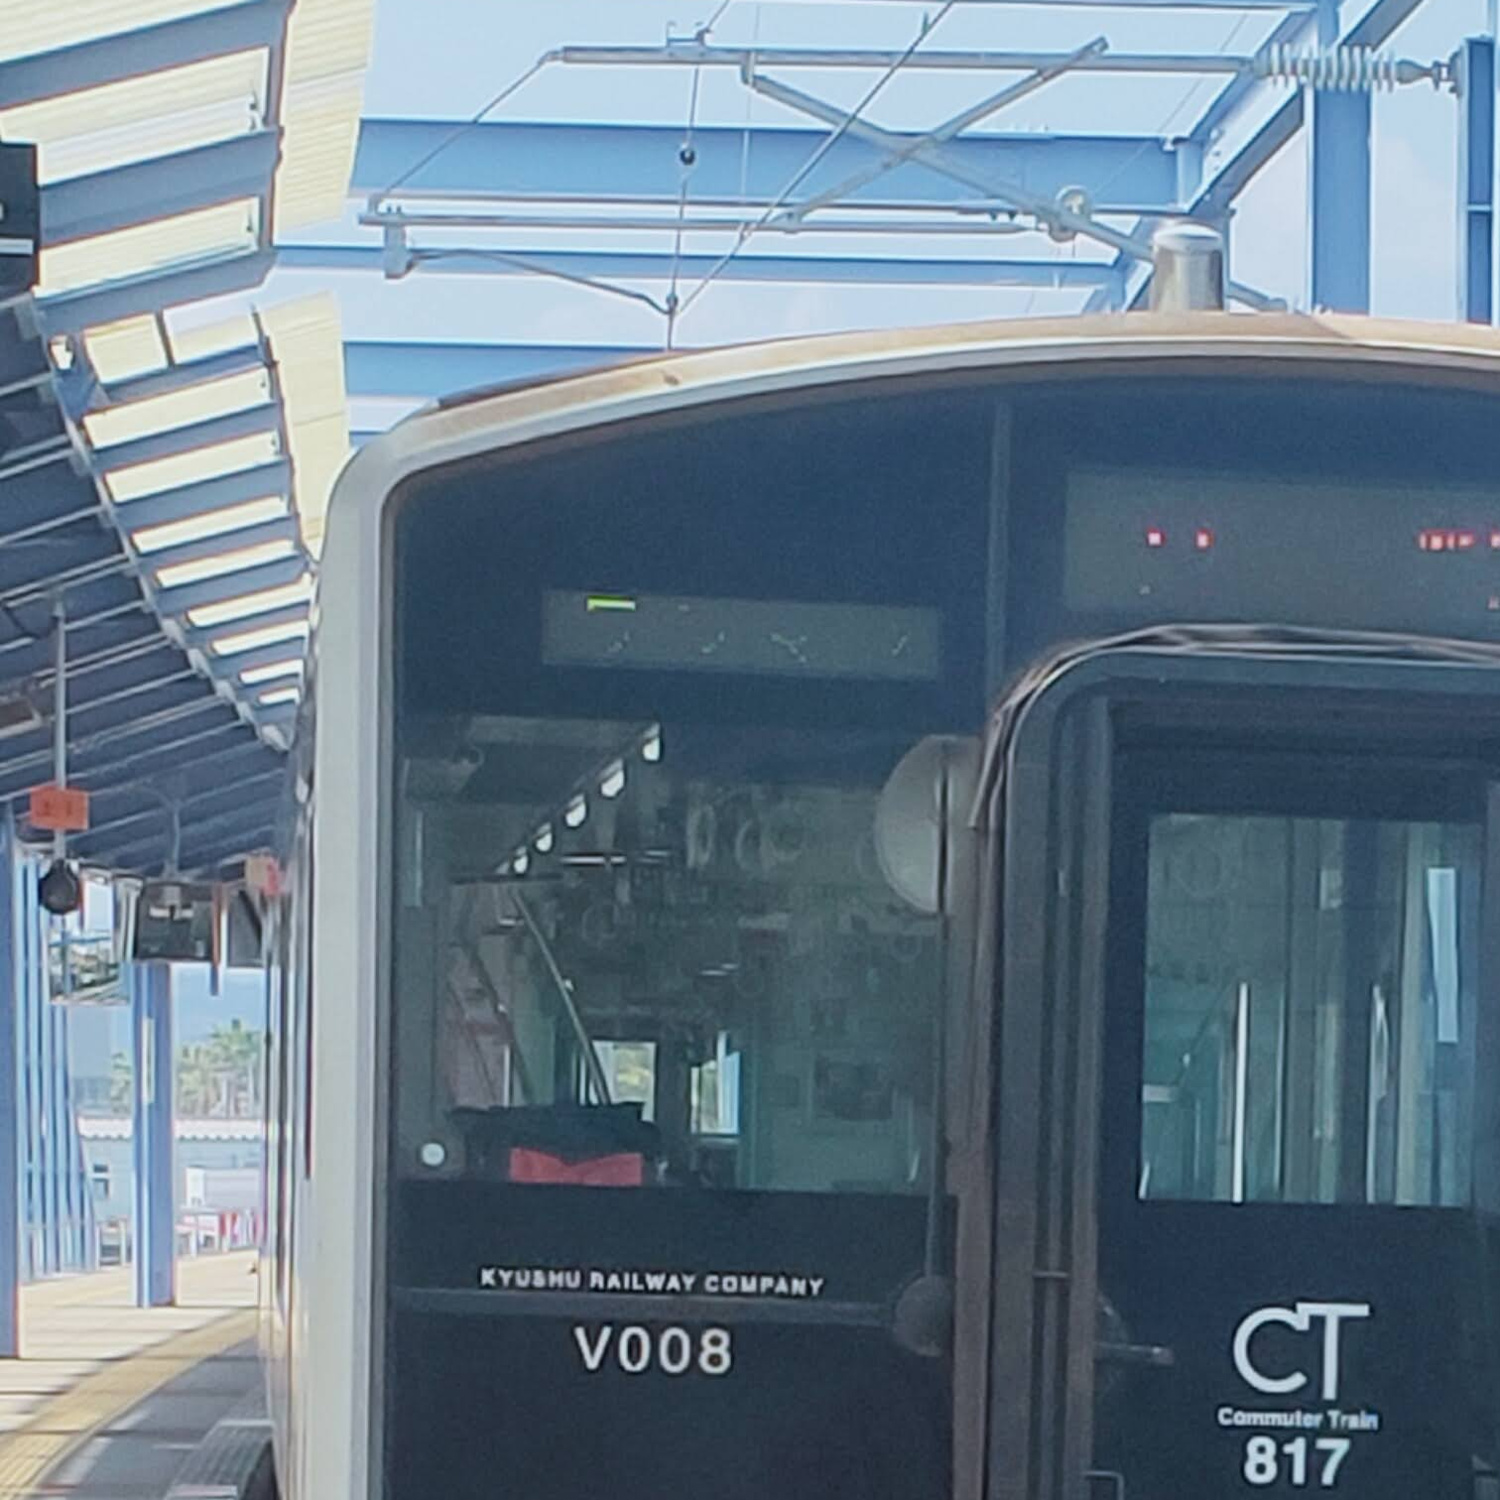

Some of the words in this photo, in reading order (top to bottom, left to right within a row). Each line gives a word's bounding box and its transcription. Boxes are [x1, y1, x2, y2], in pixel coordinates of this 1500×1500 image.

[480, 1267, 581, 1289] KYUSHU
[590, 1272, 697, 1292] RAILWAY
[704, 1275, 824, 1296] COMPANY
[573, 1325, 733, 1375] V008
[1233, 1302, 1370, 1400] CT
[1217, 1406, 1323, 1429] Commuter
[1327, 1409, 1379, 1431] Train
[1243, 1435, 1351, 1487] 817
